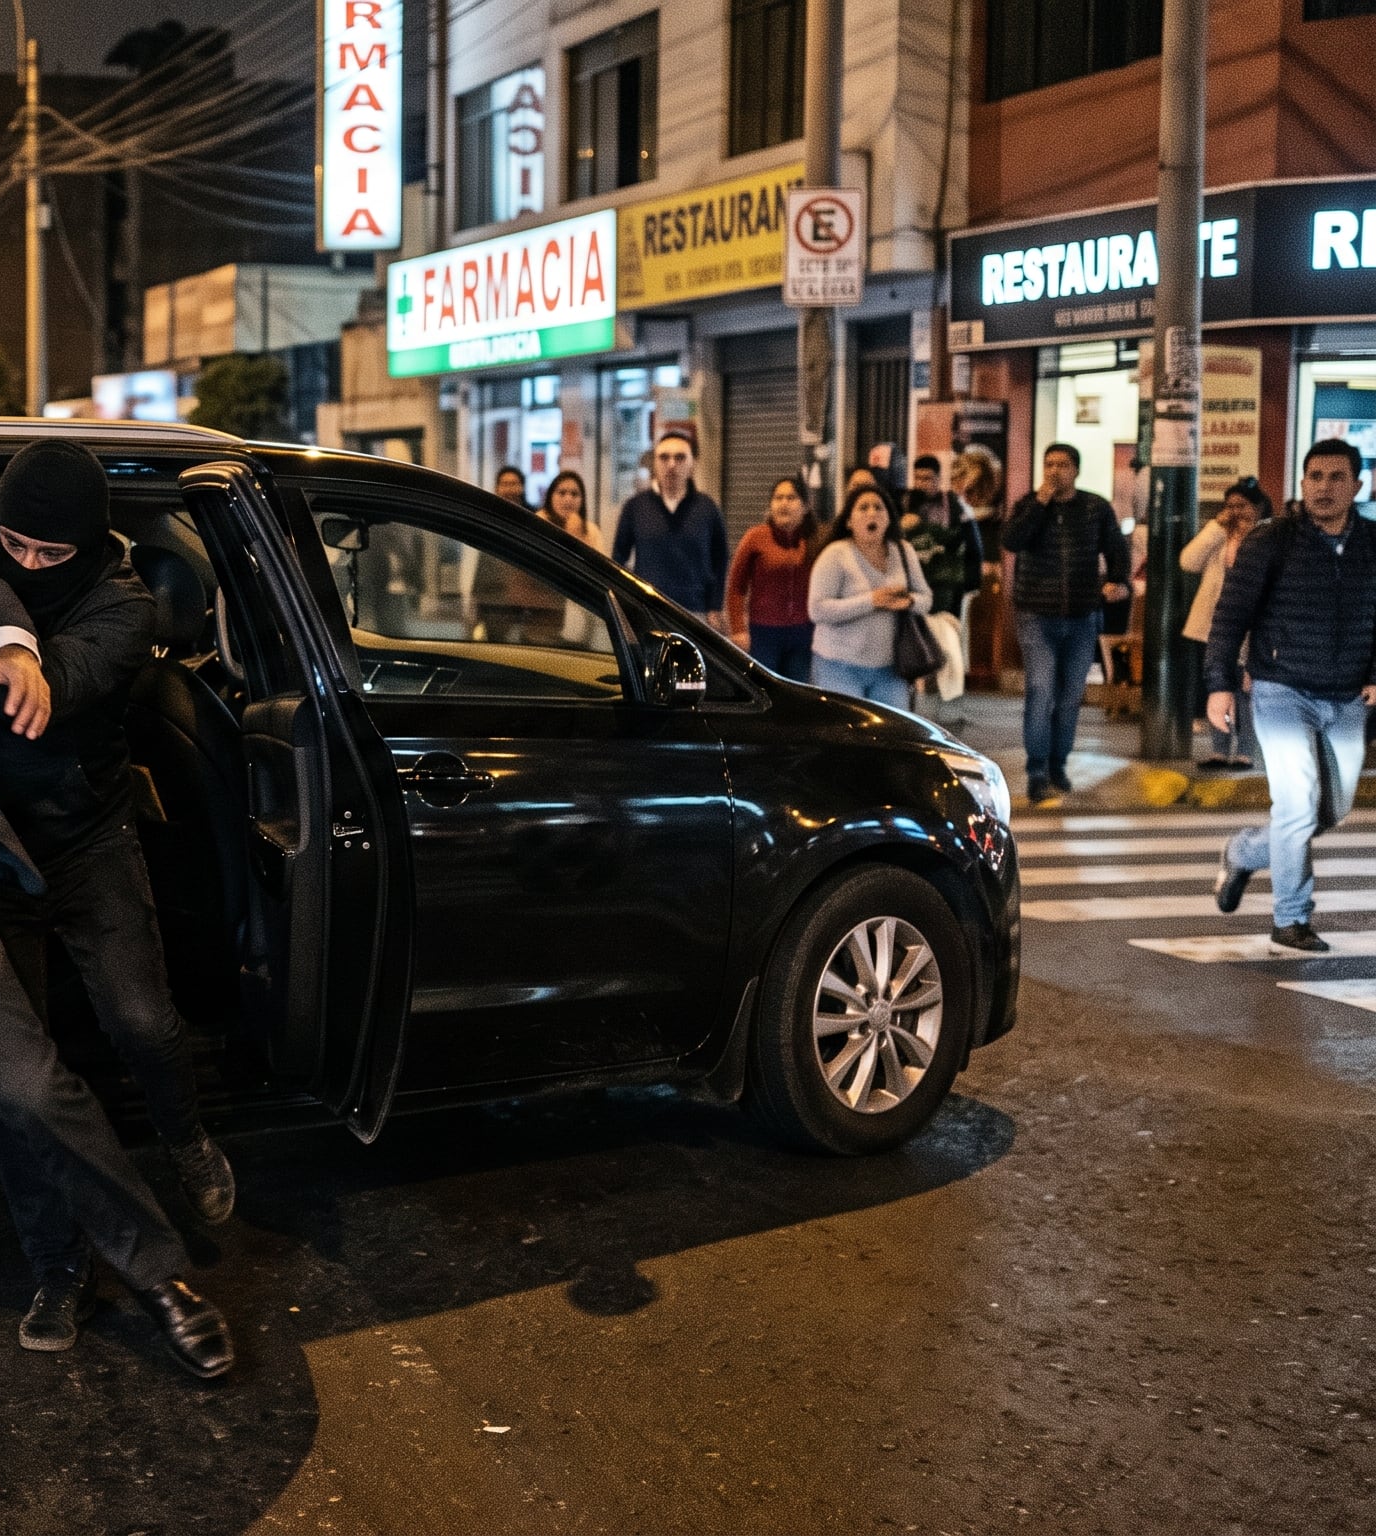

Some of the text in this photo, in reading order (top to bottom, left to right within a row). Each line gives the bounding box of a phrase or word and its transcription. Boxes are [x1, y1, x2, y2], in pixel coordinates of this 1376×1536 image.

[643, 178, 804, 258] RESTAURAN
[982, 218, 1239, 306] RESTAURAE
[423, 230, 605, 331] FARMACIA
